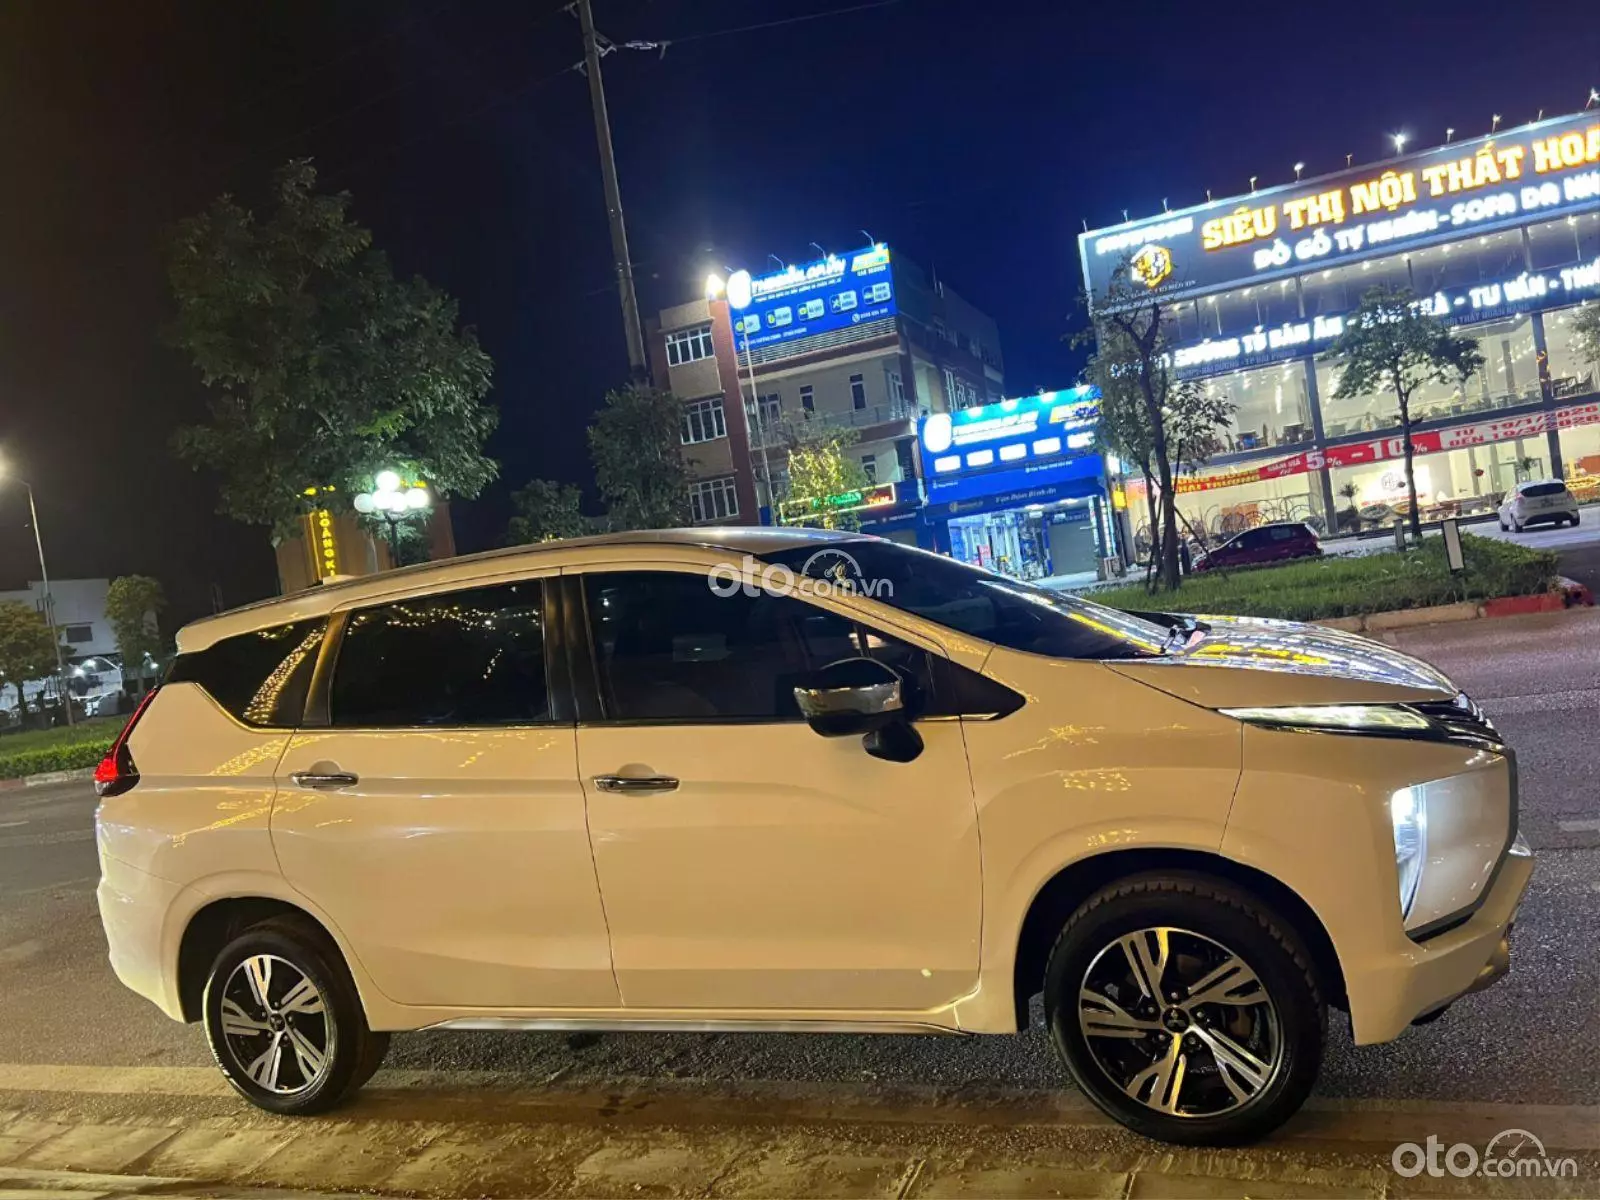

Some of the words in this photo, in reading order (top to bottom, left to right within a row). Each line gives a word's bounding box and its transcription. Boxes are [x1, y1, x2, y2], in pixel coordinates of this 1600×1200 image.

[1202, 205, 1277, 250] SIÊU
[1283, 189, 1346, 229] THỊ
[1350, 171, 1417, 215] NỘI
[1422, 140, 1524, 197] THẤT
